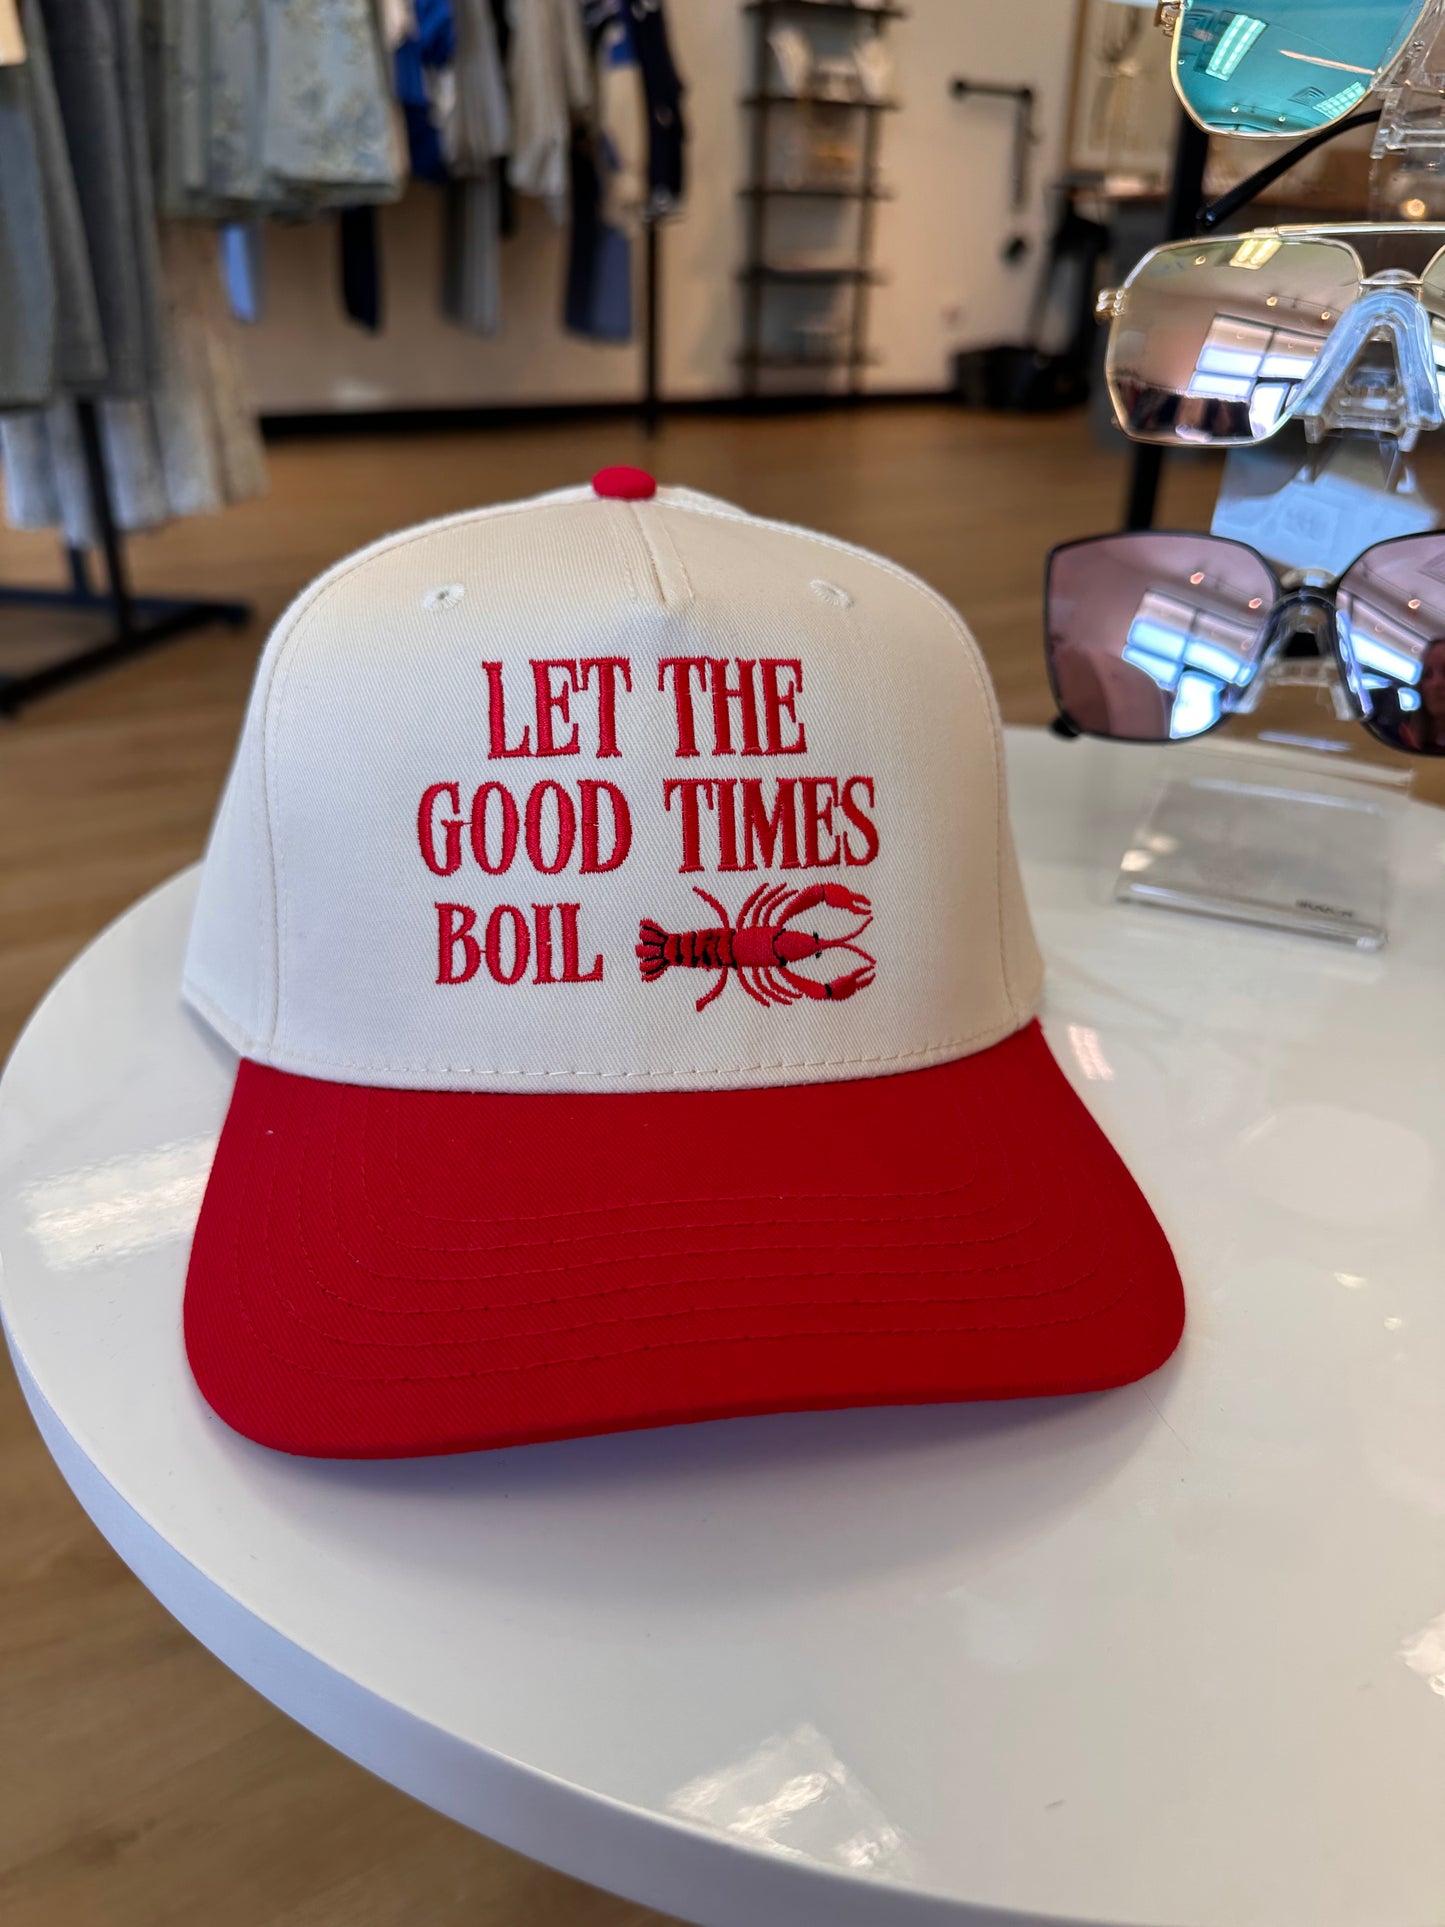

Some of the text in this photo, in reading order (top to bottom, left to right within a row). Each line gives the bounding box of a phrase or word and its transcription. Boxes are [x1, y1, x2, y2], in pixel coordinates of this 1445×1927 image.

[482, 656, 807, 759] LET THE
[418, 776, 879, 877] GOOD TIMES
[435, 903, 603, 985] BOIL
